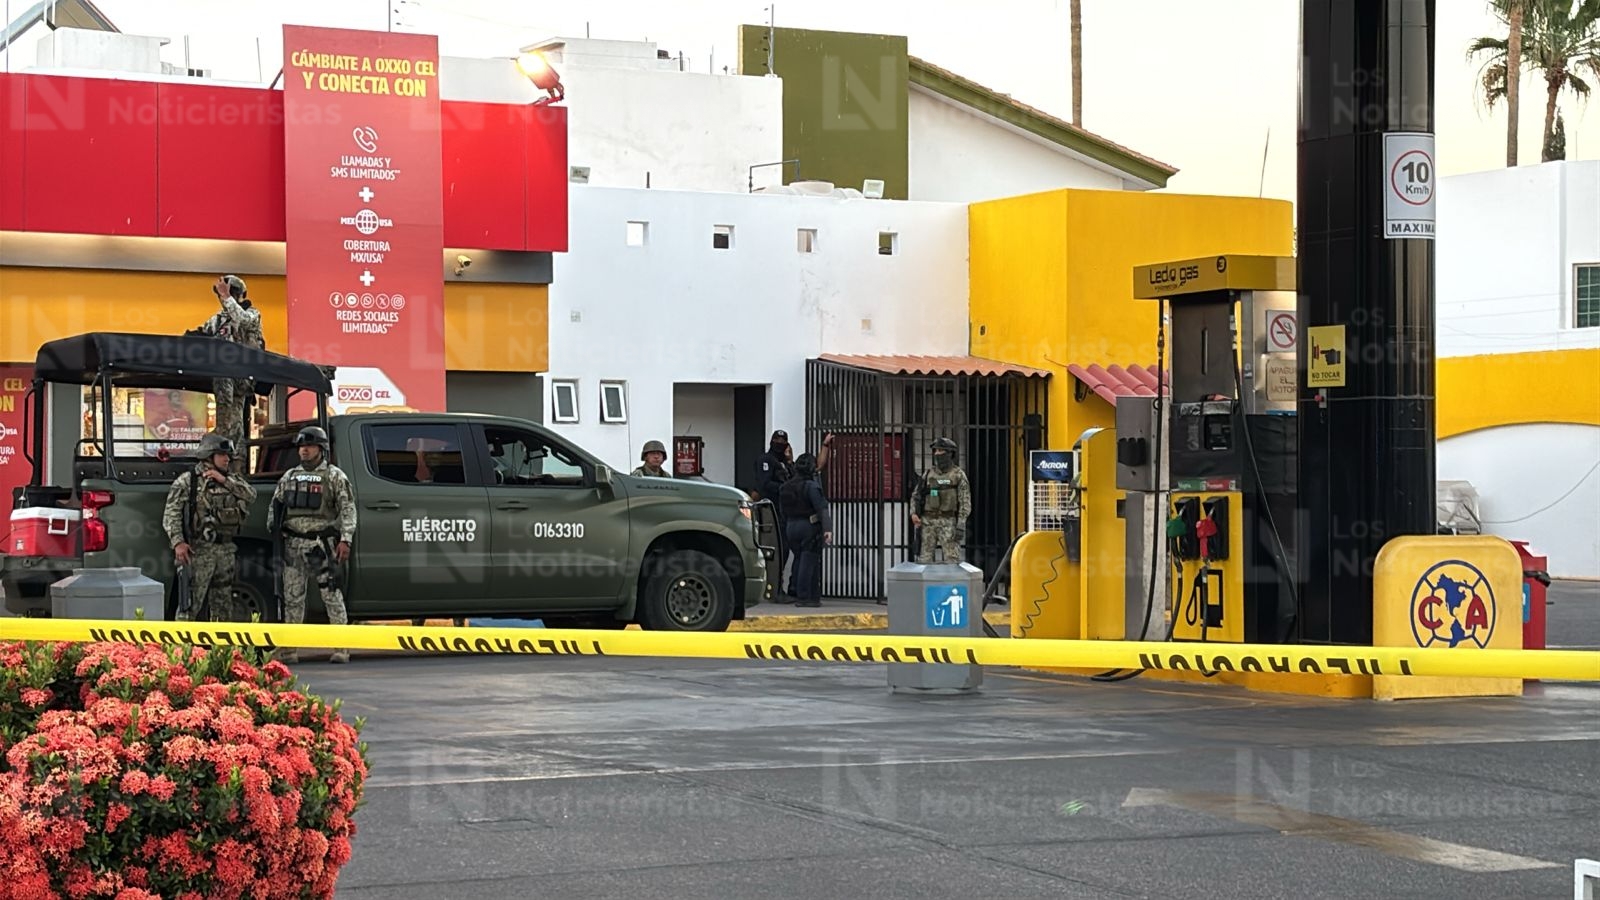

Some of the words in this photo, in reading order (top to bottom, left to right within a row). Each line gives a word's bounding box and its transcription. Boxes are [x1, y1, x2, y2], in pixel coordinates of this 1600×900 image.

[291, 49, 358, 71] CÁMBIATE
[361, 57, 372, 72] A
[375, 58, 411, 75] OXXO
[414, 61, 437, 77] CEL
[302, 71, 315, 90] Y
[318, 73, 391, 95] CONECTA
[394, 78, 427, 98] CON
[341, 155, 383, 168] LLAMADAS
[385, 157, 391, 168] Y
[331, 166, 348, 178] SMS
[1402, 161, 1429, 183] 10
[1405, 184, 1430, 195] Km/h
[341, 216, 356, 225] MEX
[379, 218, 393, 227] USA
[343, 239, 391, 252] COBERTURA
[1217, 258, 1226, 272] 3
[1179, 265, 1199, 287] gas
[336, 309, 362, 321] REDES
[363, 311, 399, 323] SOCIALES
[1321, 371, 1341, 379] TOCAR
[4, 378, 26, 392] CEL
[339, 388, 372, 401] OXXO
[375, 390, 391, 399] CEL
[163, 442, 200, 450] GRAND
[1036, 460, 1069, 470] AKRON
[402, 516, 477, 533] EJÉRCITO
[534, 522, 585, 539] 0163310
[403, 532, 476, 542] MEXICANO
[1417, 594, 1444, 630] C
[1464, 593, 1489, 630] A
